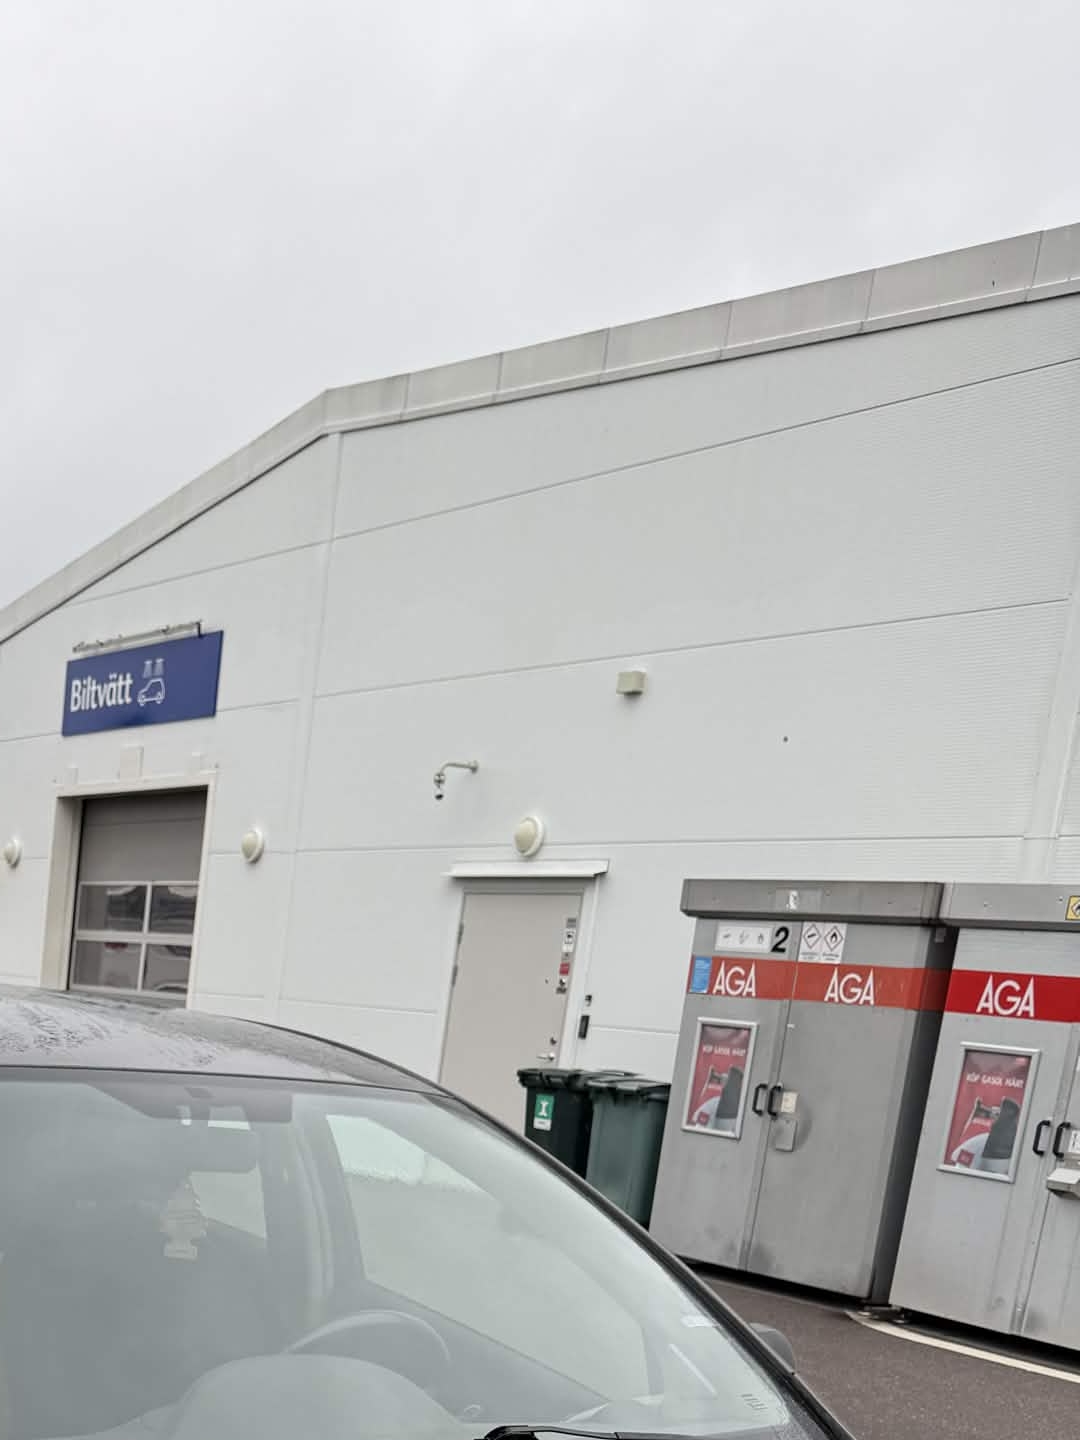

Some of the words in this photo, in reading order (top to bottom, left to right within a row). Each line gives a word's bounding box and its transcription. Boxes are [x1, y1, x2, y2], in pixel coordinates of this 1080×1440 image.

[70, 672, 133, 713] Biltvätt
[771, 925, 790, 954] 2
[712, 960, 757, 998] AGA
[823, 967, 875, 1006] AGA
[976, 974, 1036, 1018] AGA
